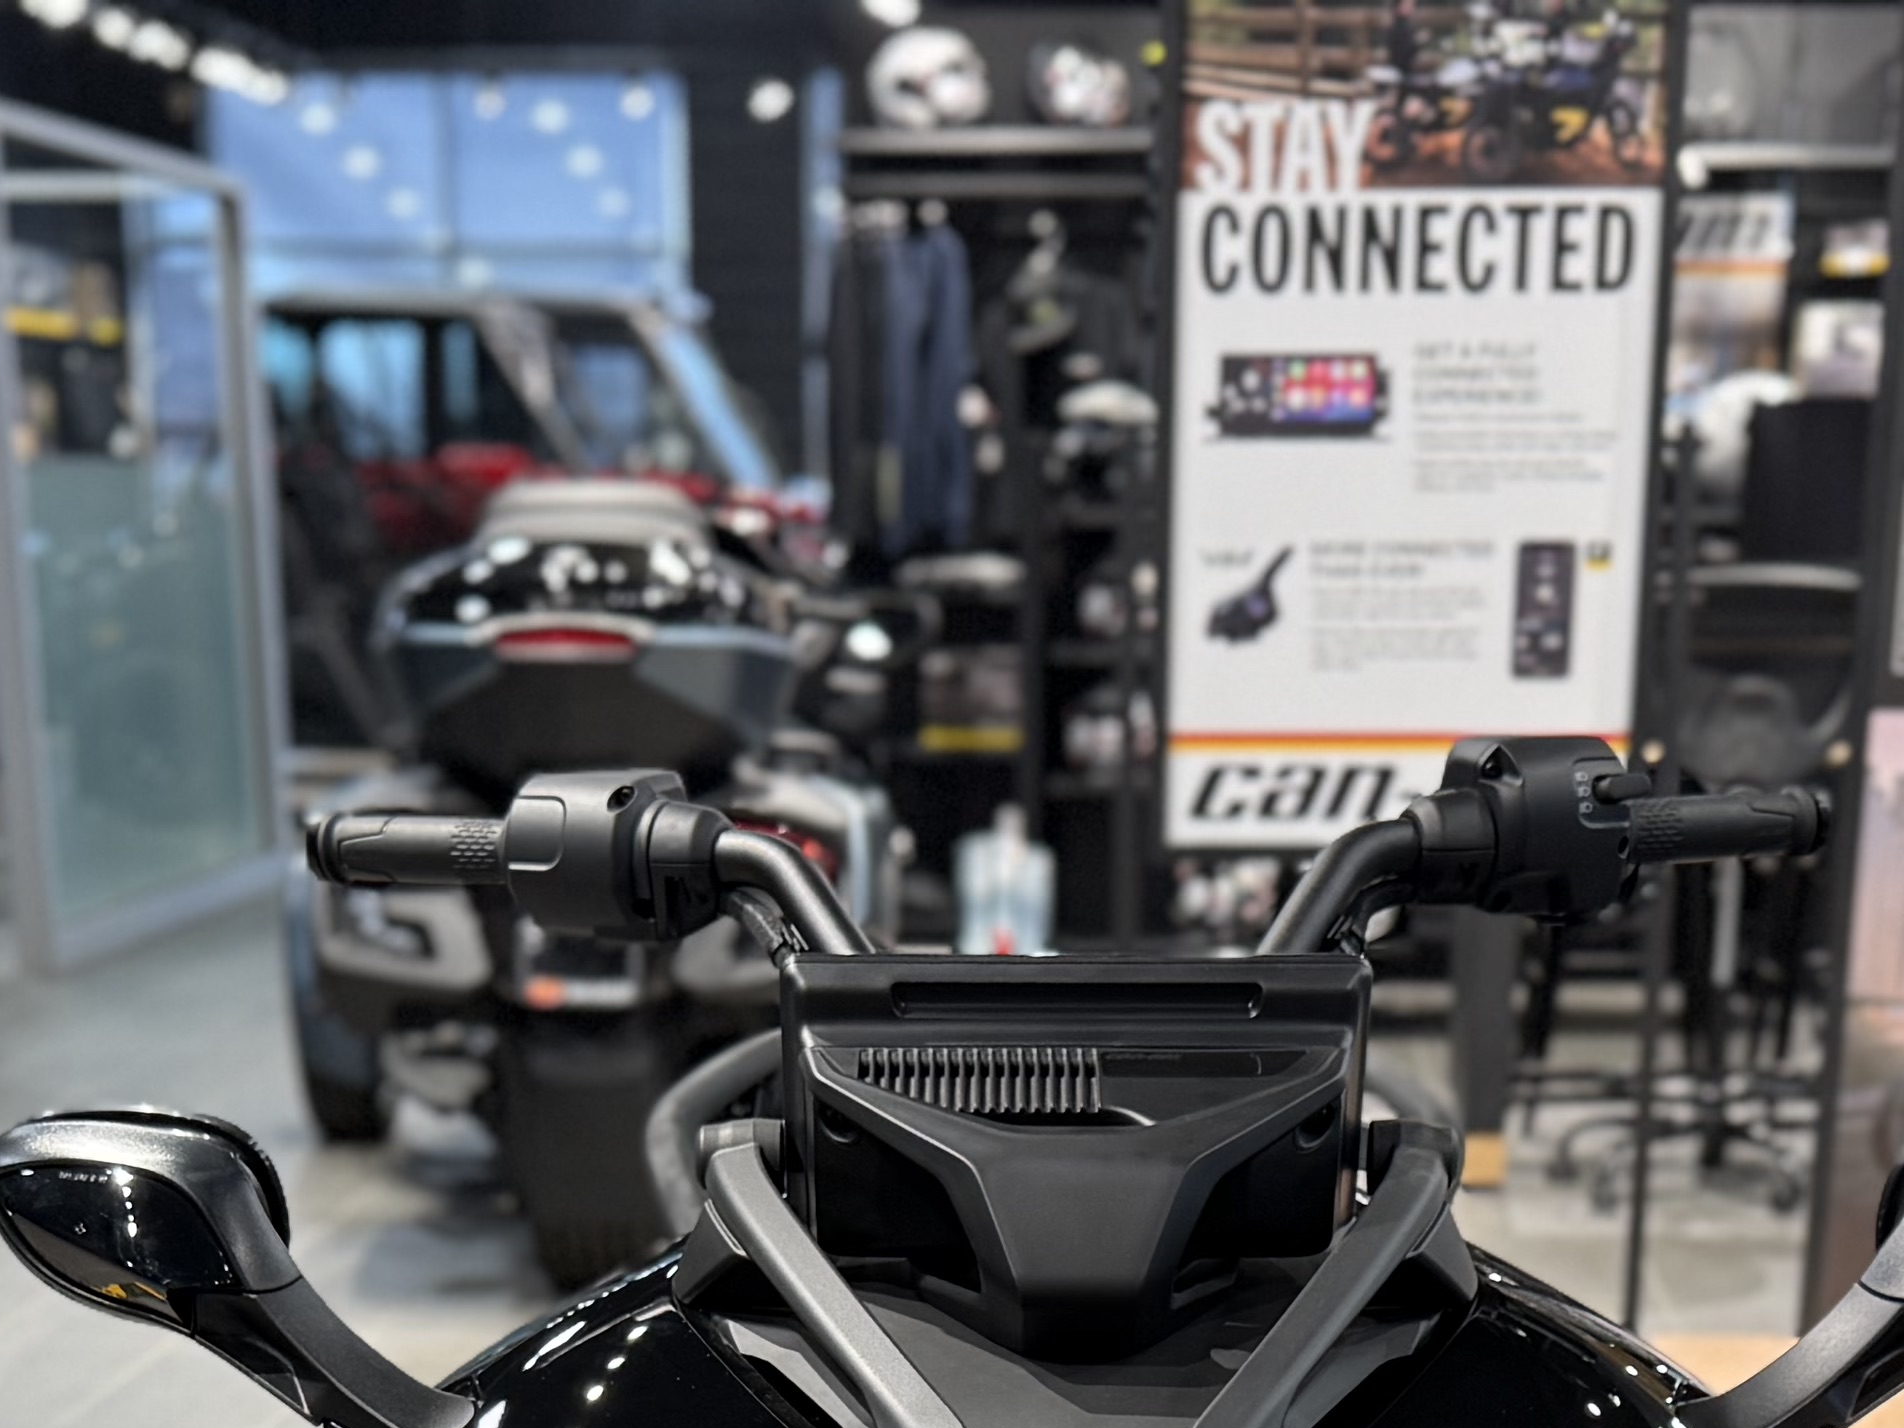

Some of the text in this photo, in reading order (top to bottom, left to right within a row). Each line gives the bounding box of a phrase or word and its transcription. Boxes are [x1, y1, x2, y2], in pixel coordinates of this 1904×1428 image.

[1198, 99, 1373, 192] STAY
[1202, 204, 1634, 293] CONNECTED
[1189, 761, 1426, 823] can-
